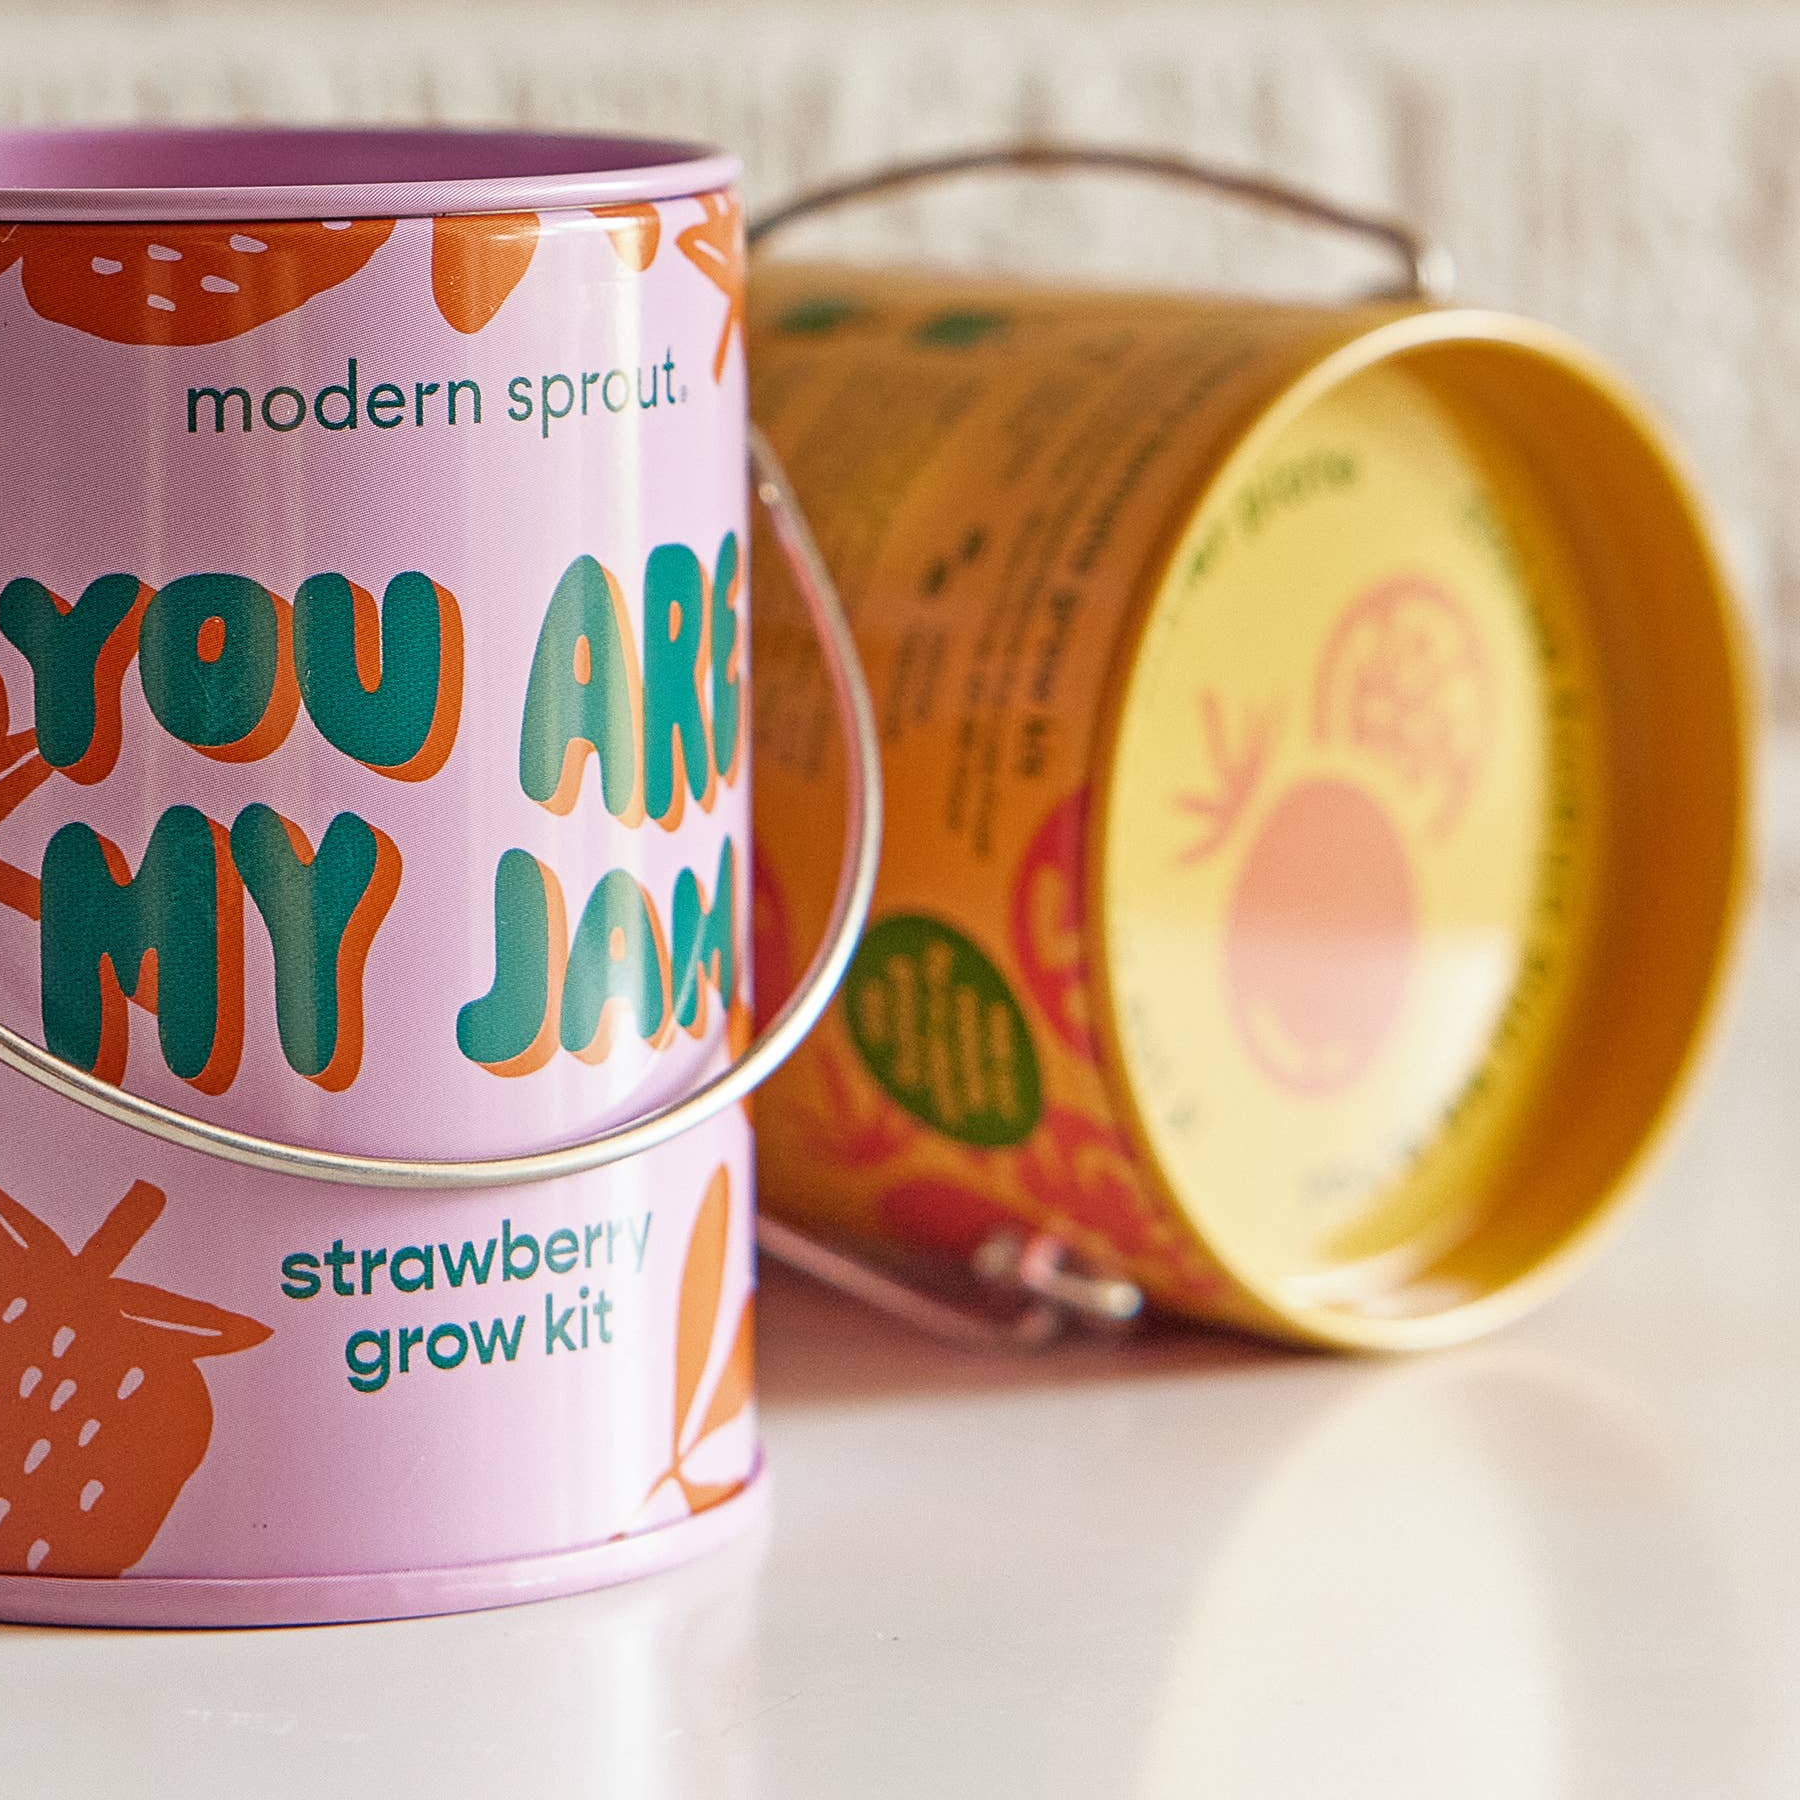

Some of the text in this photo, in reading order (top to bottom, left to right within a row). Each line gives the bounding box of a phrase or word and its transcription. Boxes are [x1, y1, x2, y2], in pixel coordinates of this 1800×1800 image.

[187, 357, 484, 434] modern
[519, 529, 747, 834] ARE
[40, 802, 403, 1097] MY
[455, 833, 741, 1079] JAM
[281, 1210, 653, 1300] strawberry
[345, 1286, 614, 1393] grow kit
